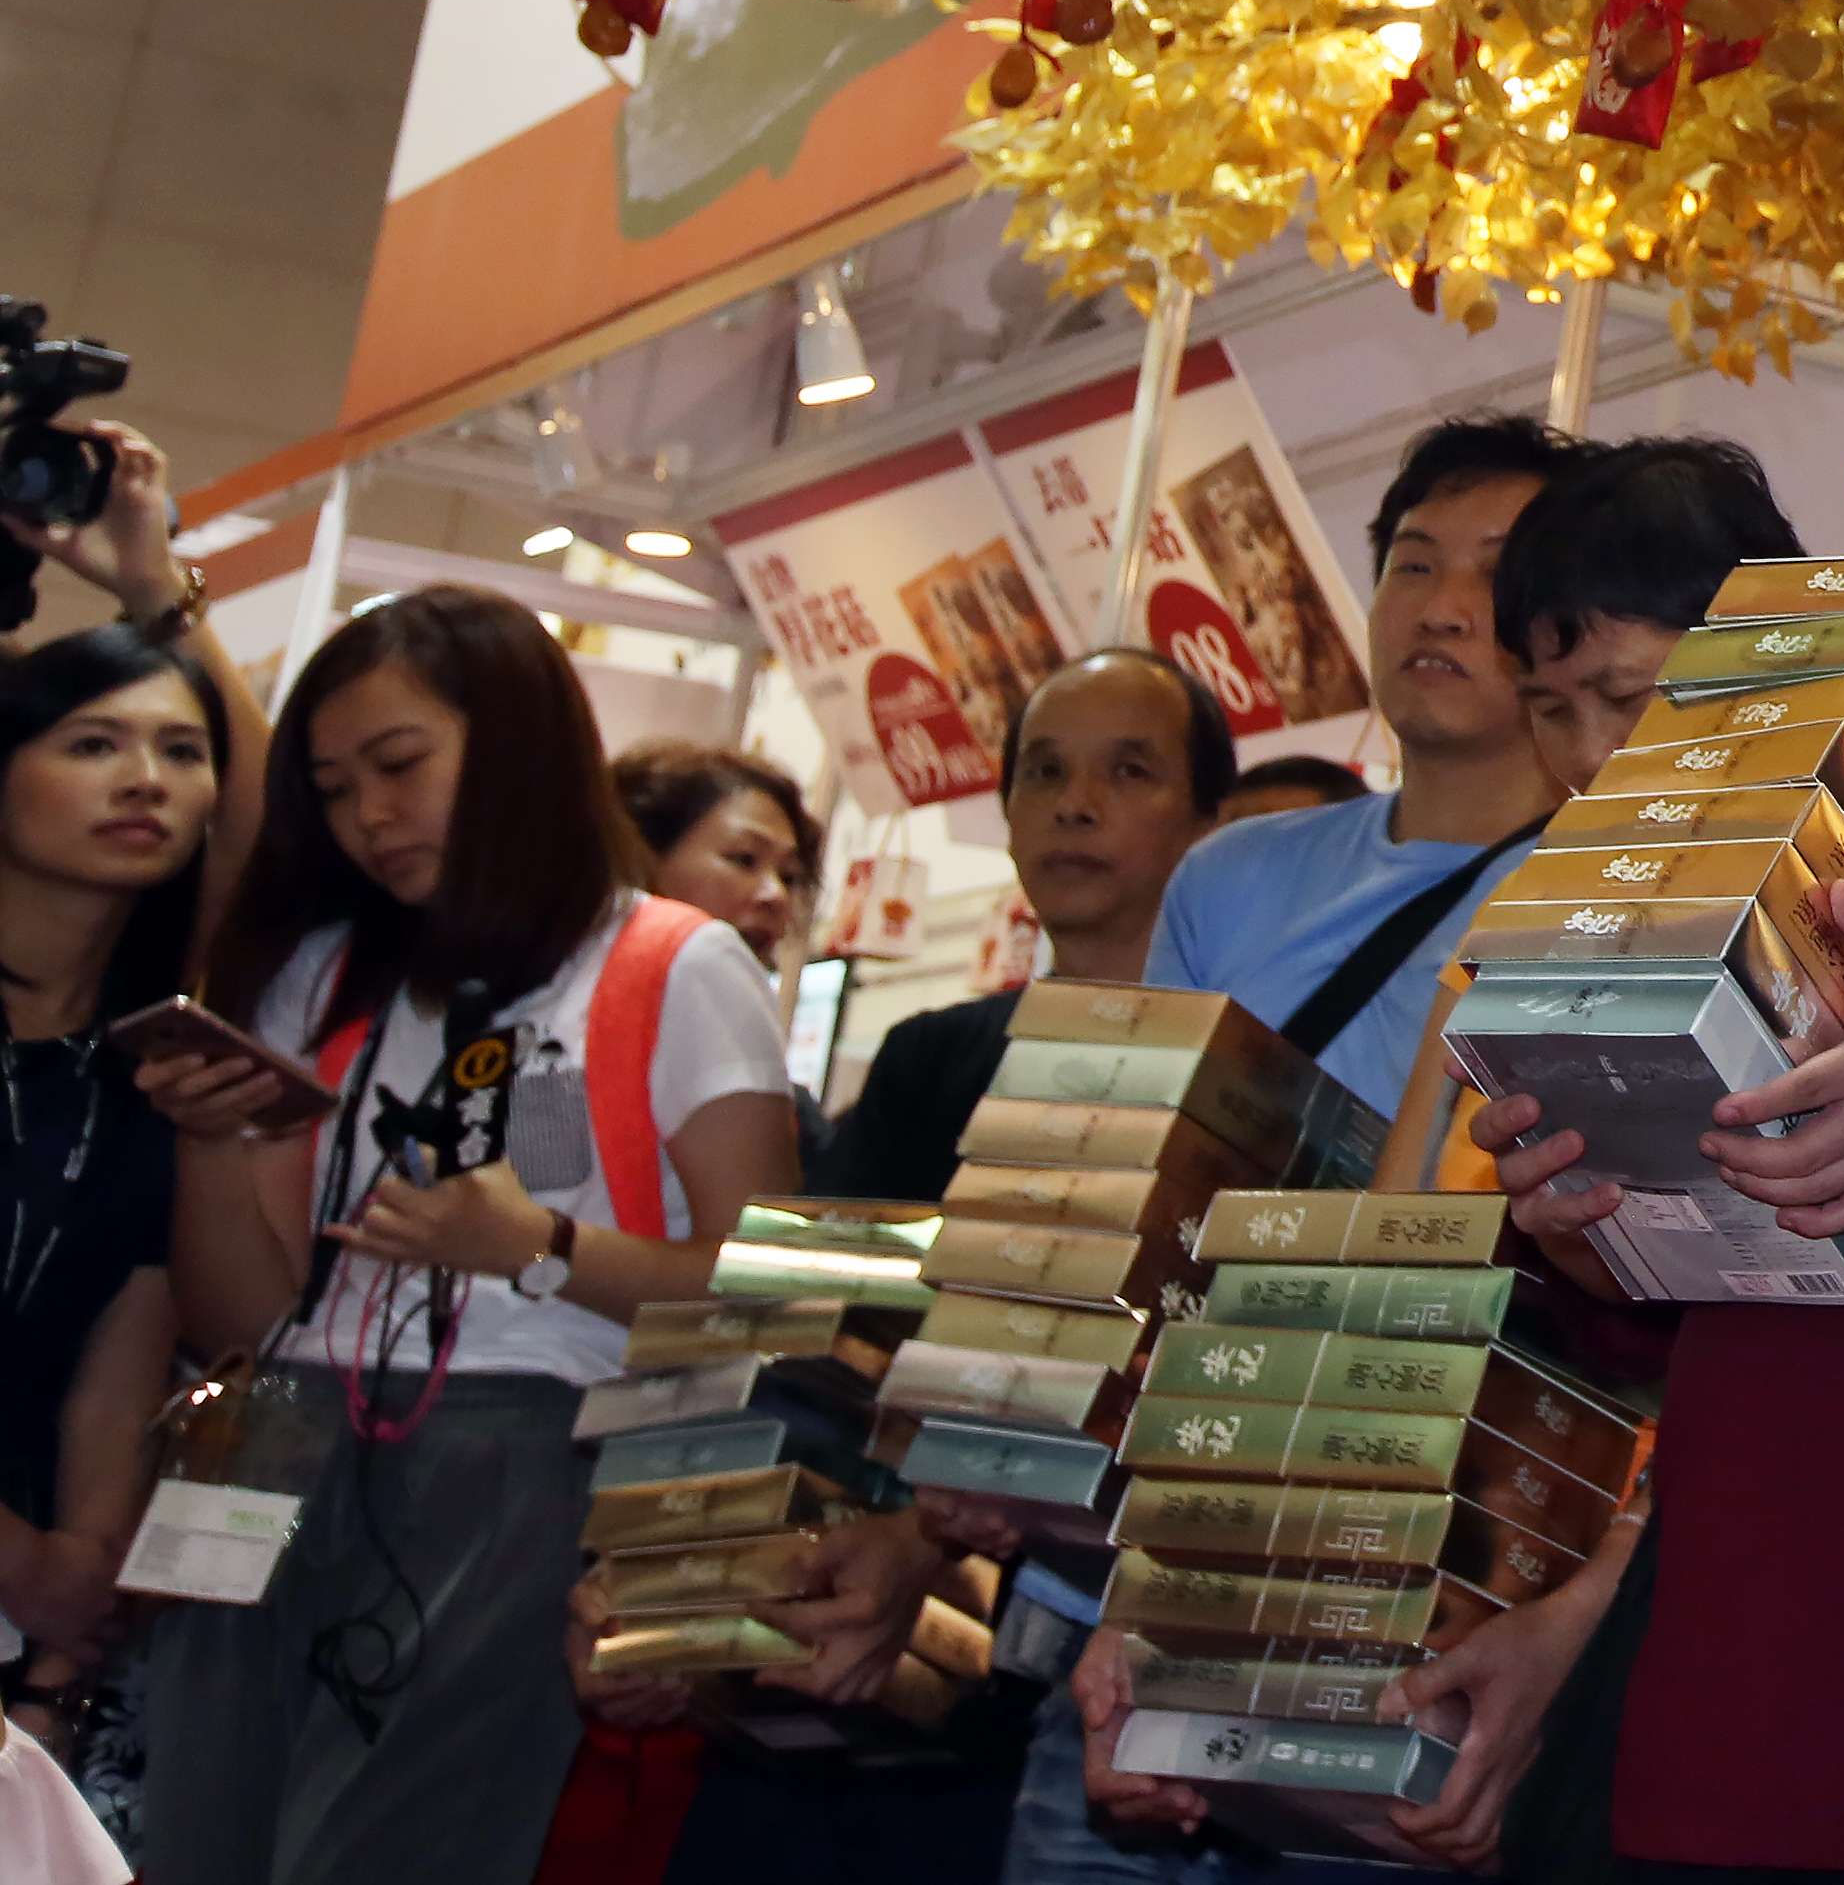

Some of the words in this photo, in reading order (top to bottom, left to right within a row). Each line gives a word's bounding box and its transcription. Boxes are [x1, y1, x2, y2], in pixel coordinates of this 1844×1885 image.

[1246, 1207, 1306, 1247] 安記
[1200, 1343, 1266, 1386] 安記
[1176, 1415, 1241, 1459] 安記
